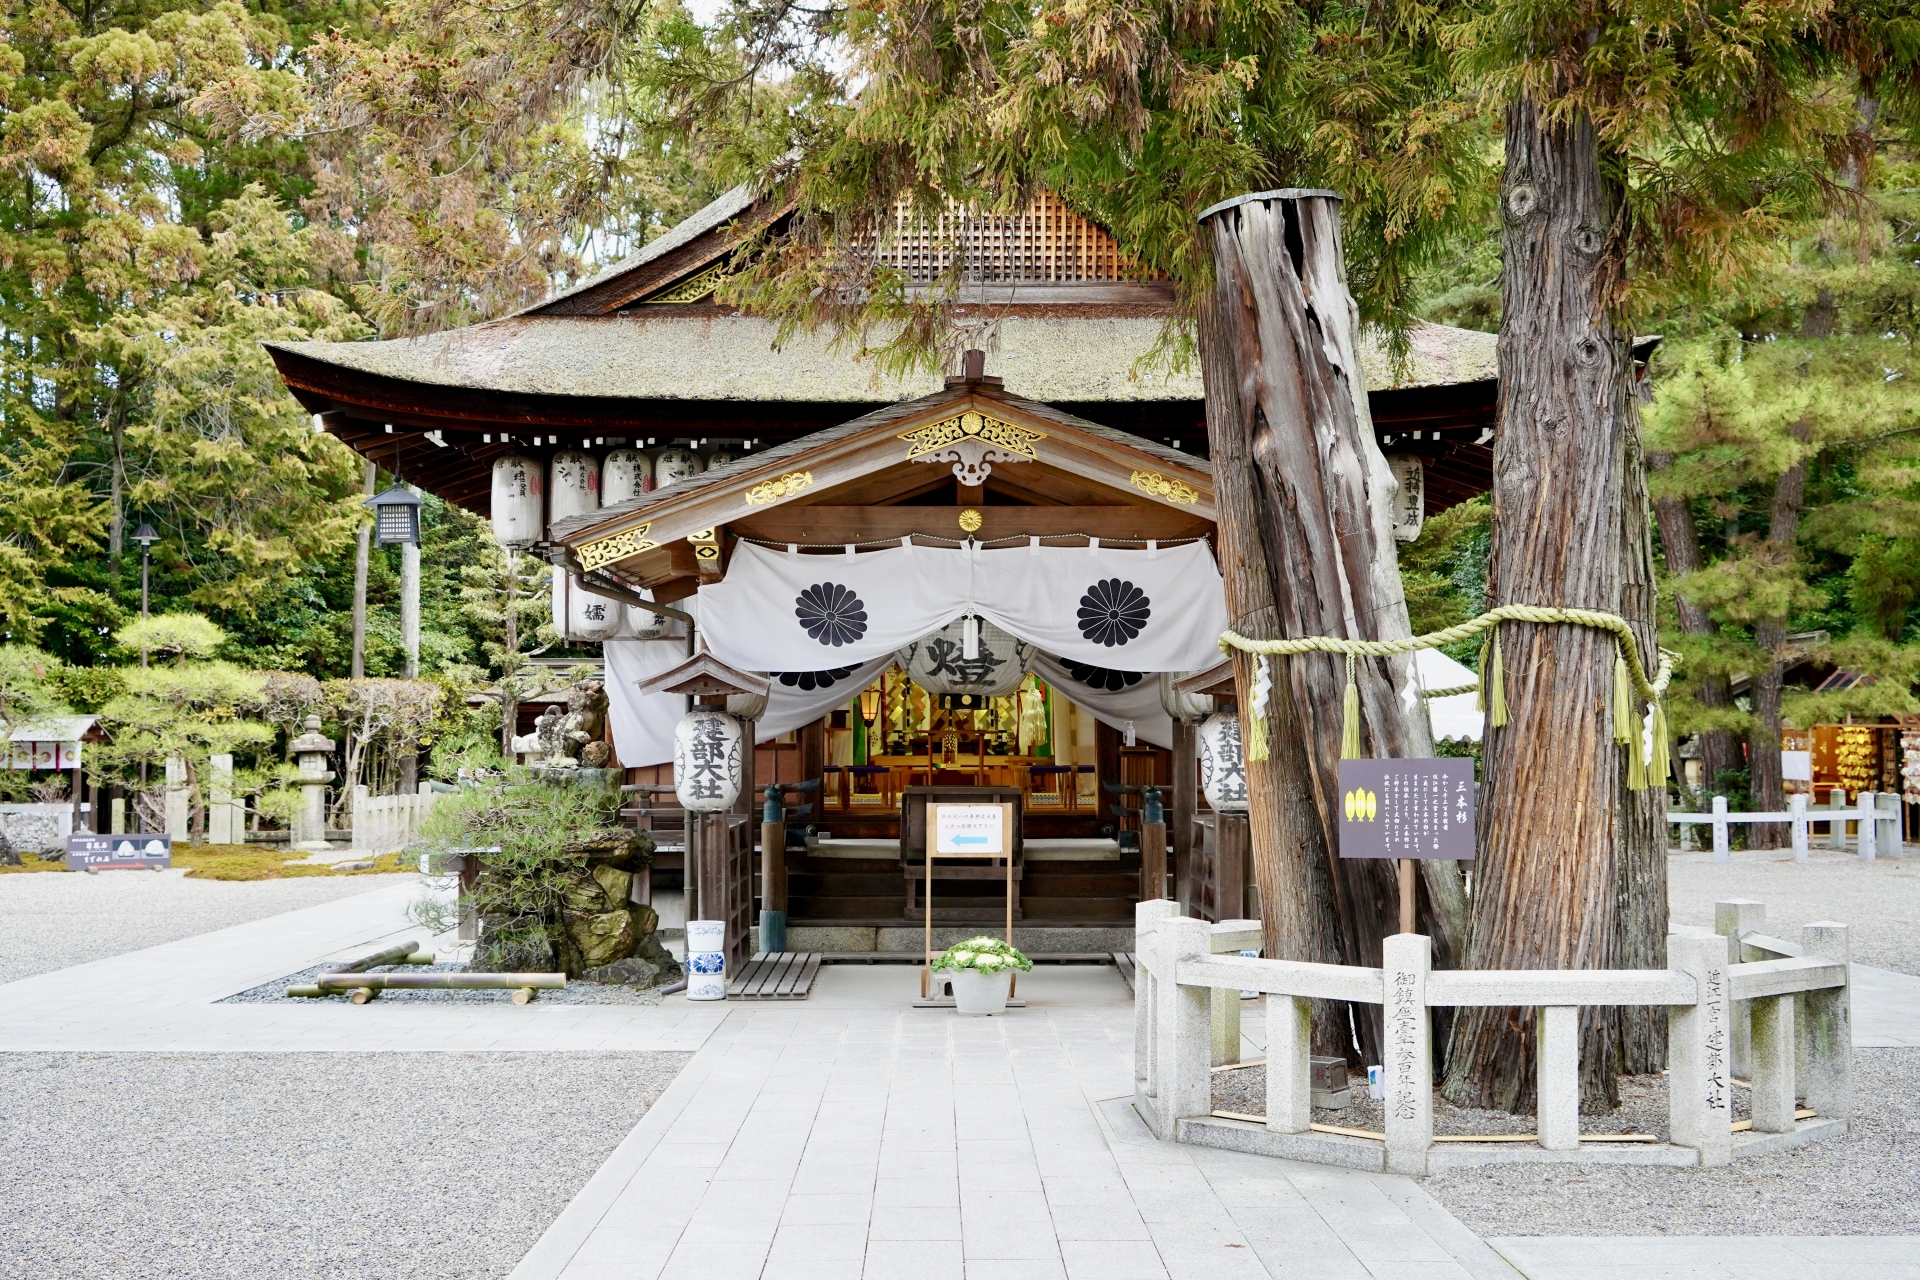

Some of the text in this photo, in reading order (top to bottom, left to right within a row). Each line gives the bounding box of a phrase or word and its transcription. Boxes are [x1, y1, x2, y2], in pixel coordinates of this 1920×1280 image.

[632, 463, 642, 496] 株式会社
[687, 717, 731, 801] 建部大社
[1455, 780, 1468, 824] 三本杉
